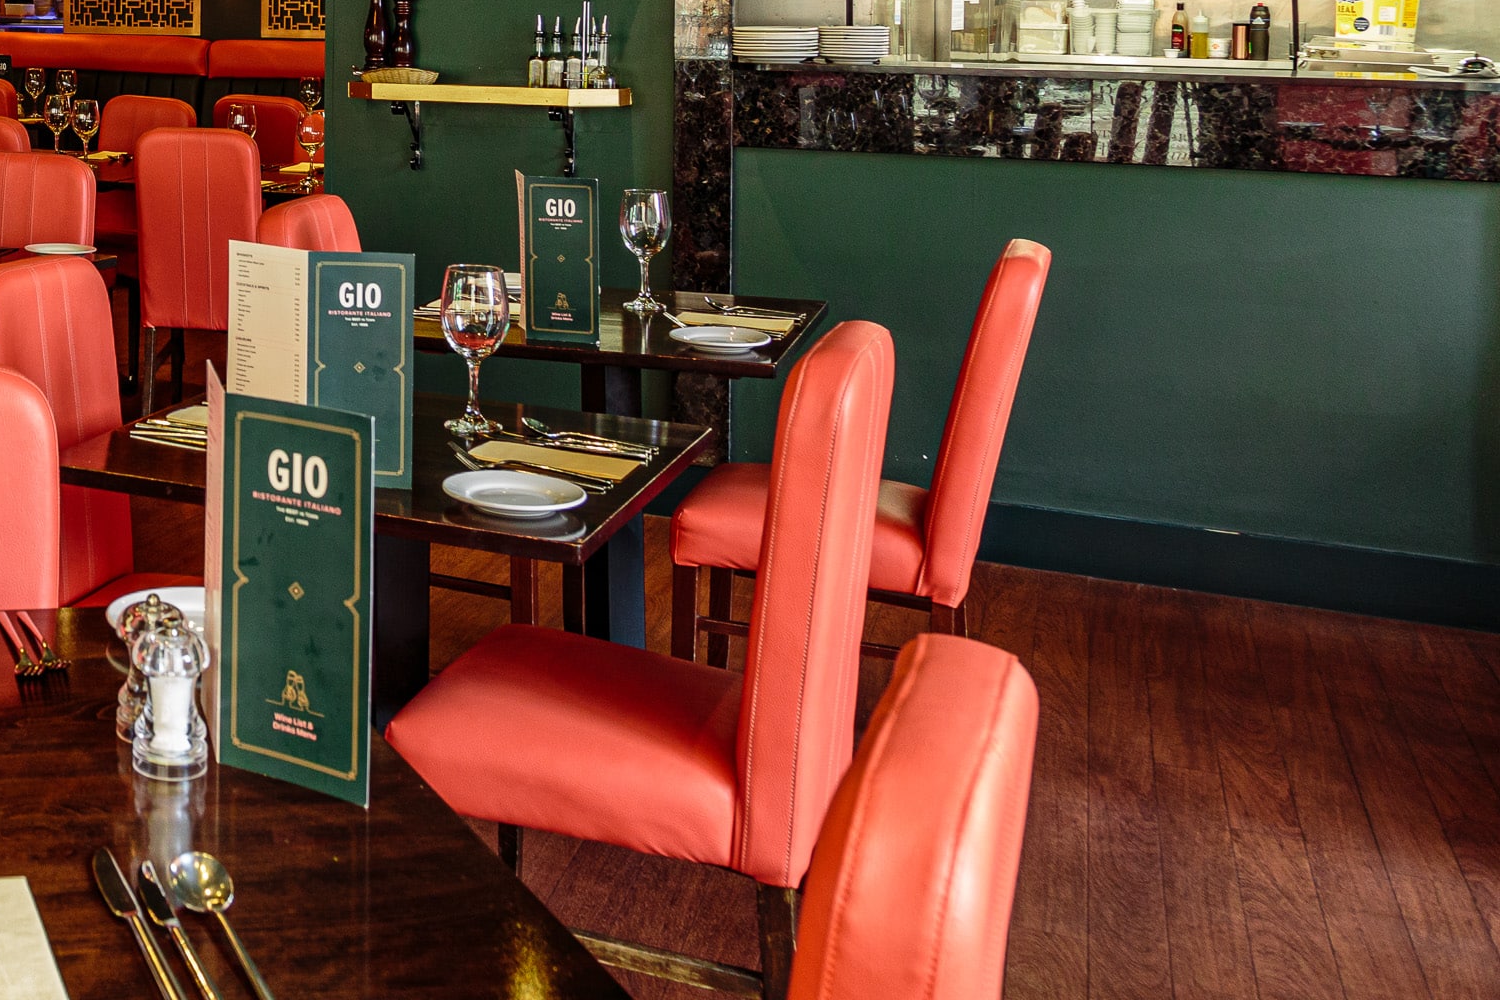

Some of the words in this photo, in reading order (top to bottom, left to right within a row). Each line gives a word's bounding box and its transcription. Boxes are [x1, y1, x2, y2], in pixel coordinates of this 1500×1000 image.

[545, 198, 576, 217] GIO
[339, 281, 382, 309] GIO
[364, 310, 392, 318] ITALIANO
[267, 448, 328, 498] GIO
[252, 490, 302, 507] RISTORANTE
[303, 500, 342, 516] ITALIANO
